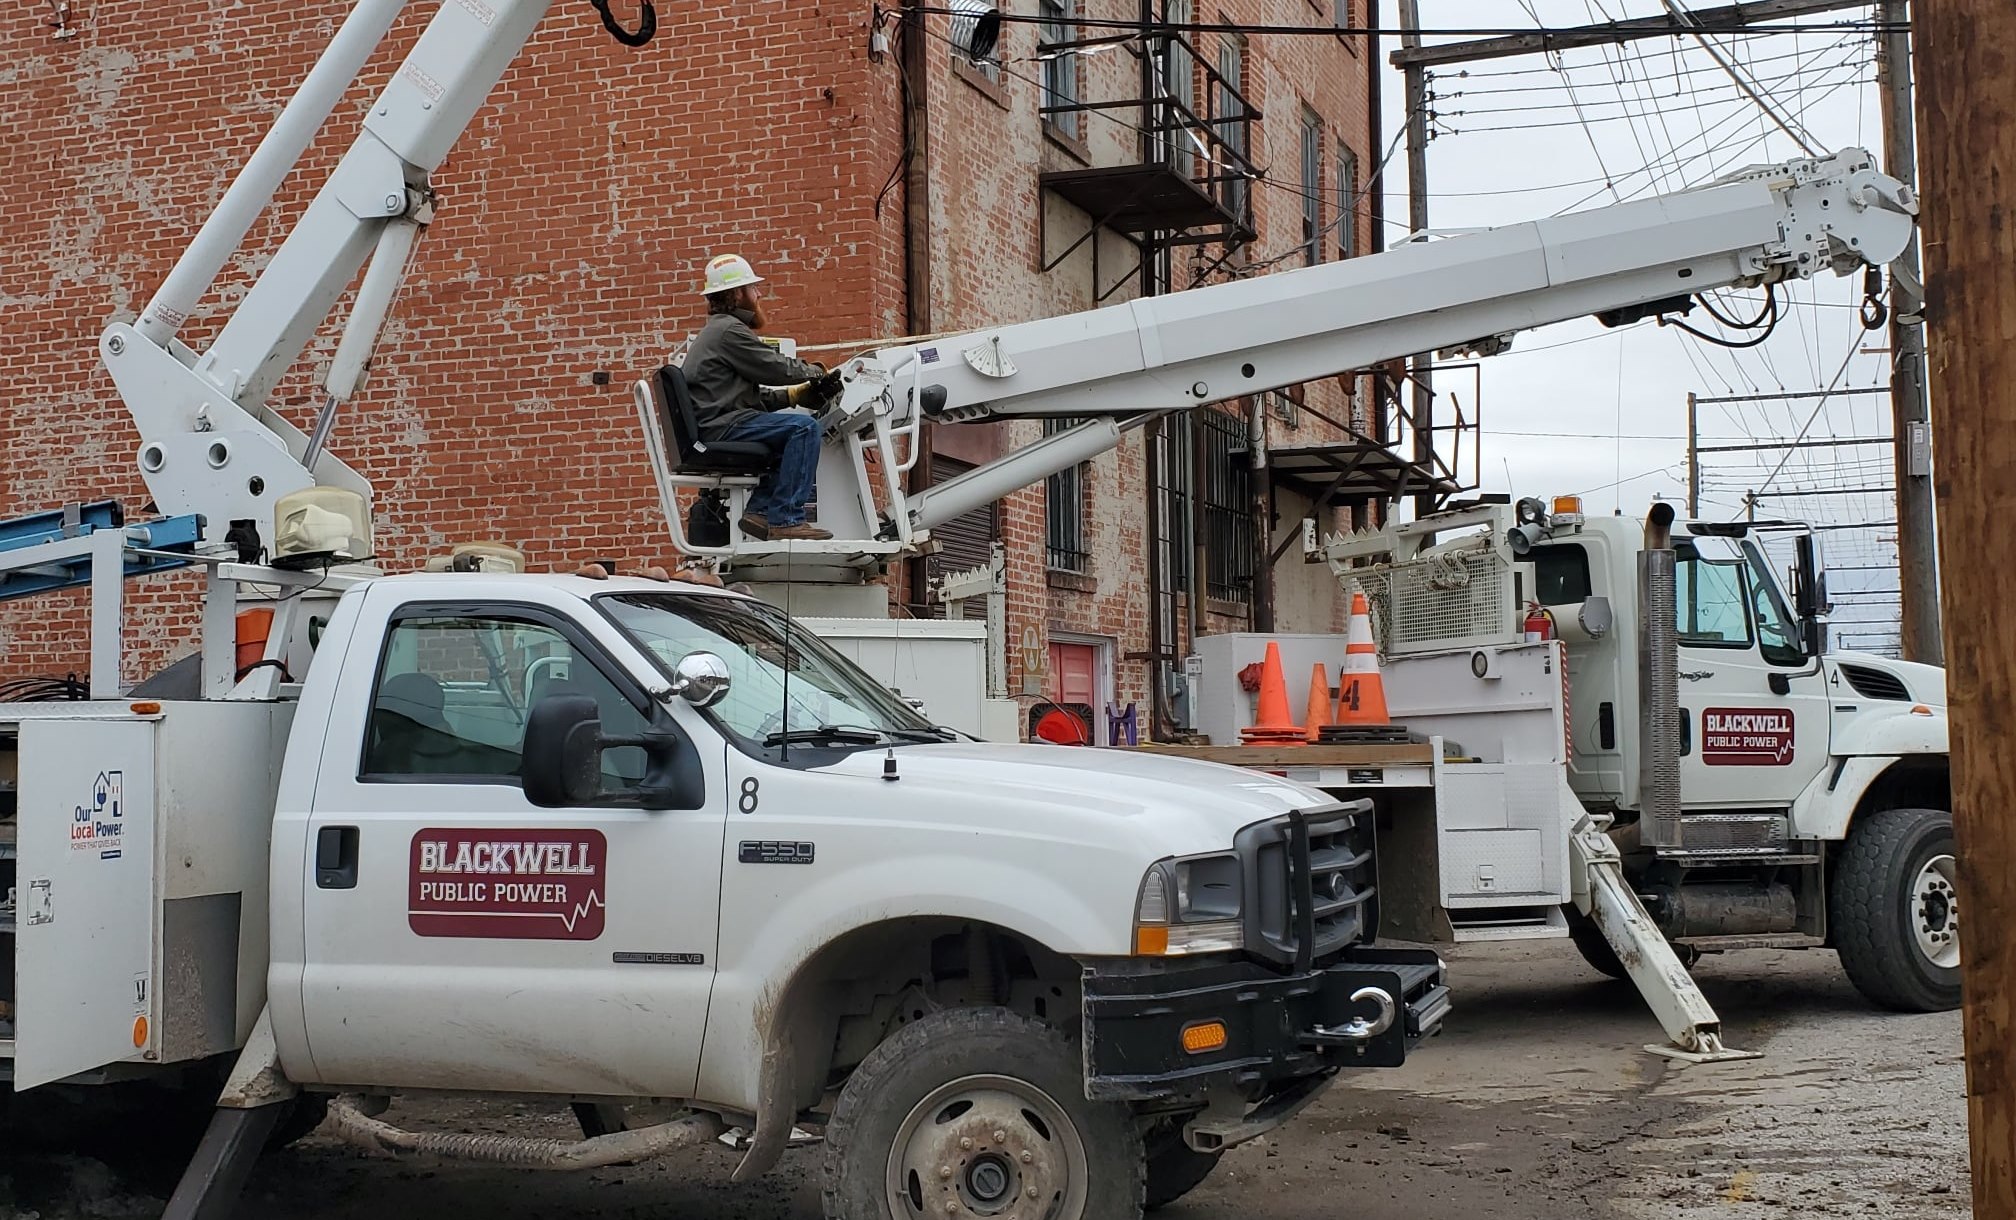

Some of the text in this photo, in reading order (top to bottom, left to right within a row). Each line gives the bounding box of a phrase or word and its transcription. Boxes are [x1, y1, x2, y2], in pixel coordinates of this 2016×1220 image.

[1830, 669, 1839, 688] 4
[1341, 679, 1360, 711] 4
[1706, 714, 1790, 733] BLACKWELL
[1707, 736, 1778, 747] PUBLIC POWER
[738, 776, 760, 815] 8
[75, 805, 92, 822] Our
[71, 821, 95, 840] Local
[419, 841, 596, 875] BLACKWELL
[419, 882, 568, 903] PUBLIC POWER
[646, 953, 686, 963] DIESEL
[686, 953, 701, 963] V8
